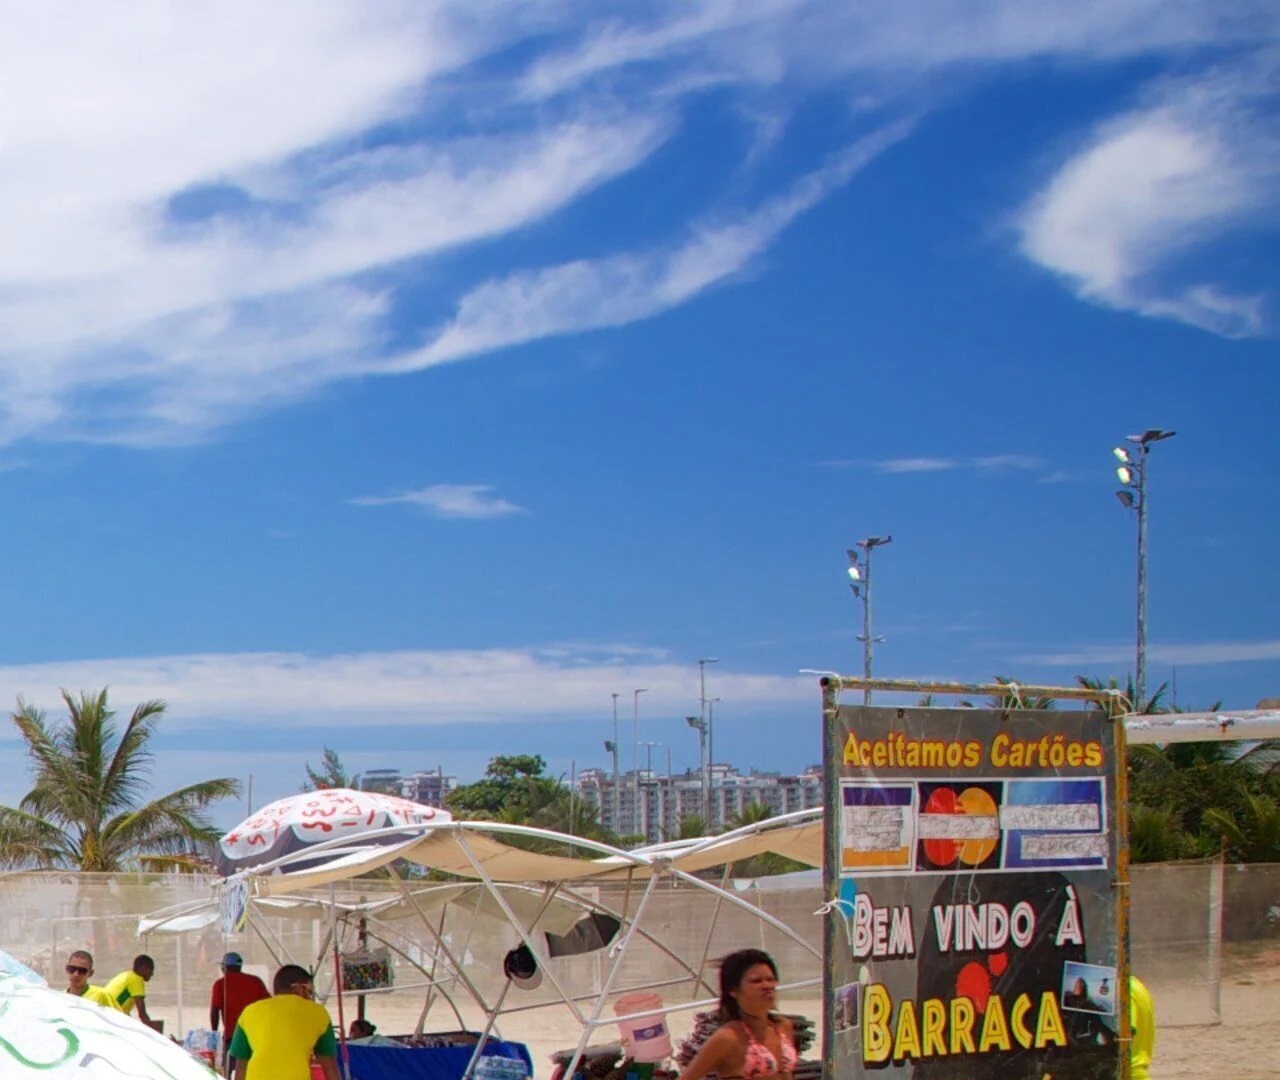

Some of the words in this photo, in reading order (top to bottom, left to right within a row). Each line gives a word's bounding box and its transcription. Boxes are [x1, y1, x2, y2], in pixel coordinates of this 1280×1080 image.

[842, 730, 981, 768] Aceitamos
[989, 732, 1104, 768] Cartões
[852, 891, 915, 957] BEM
[933, 900, 1037, 953] VINDO
[1054, 884, 1084, 947] À
[862, 984, 1068, 1068] BARRACA
